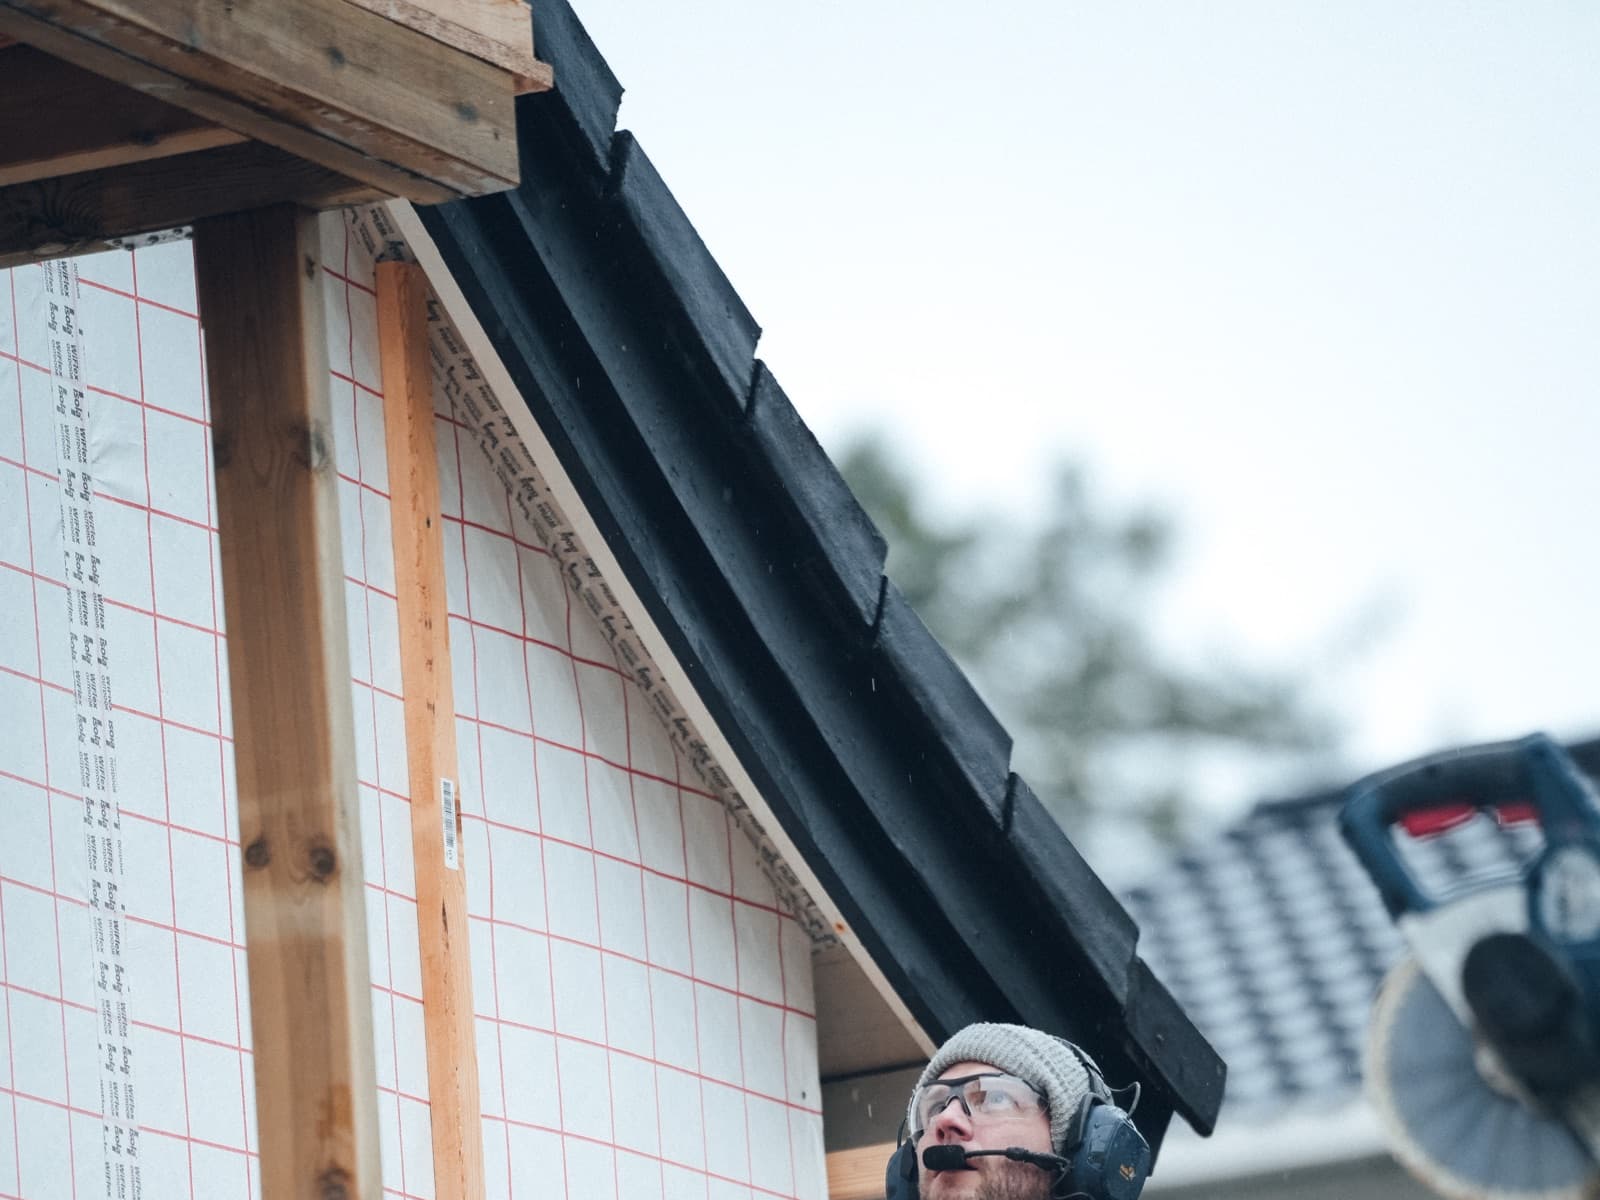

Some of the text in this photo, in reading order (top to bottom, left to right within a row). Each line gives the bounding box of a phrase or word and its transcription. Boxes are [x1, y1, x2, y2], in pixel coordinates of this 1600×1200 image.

[70, 344, 79, 381] WiFlex
[80, 428, 88, 464] WiFlex
[88, 512, 96, 547] WiFlex
[97, 594, 105, 630] WiFlex
[81, 591, 89, 627] WiFlex
